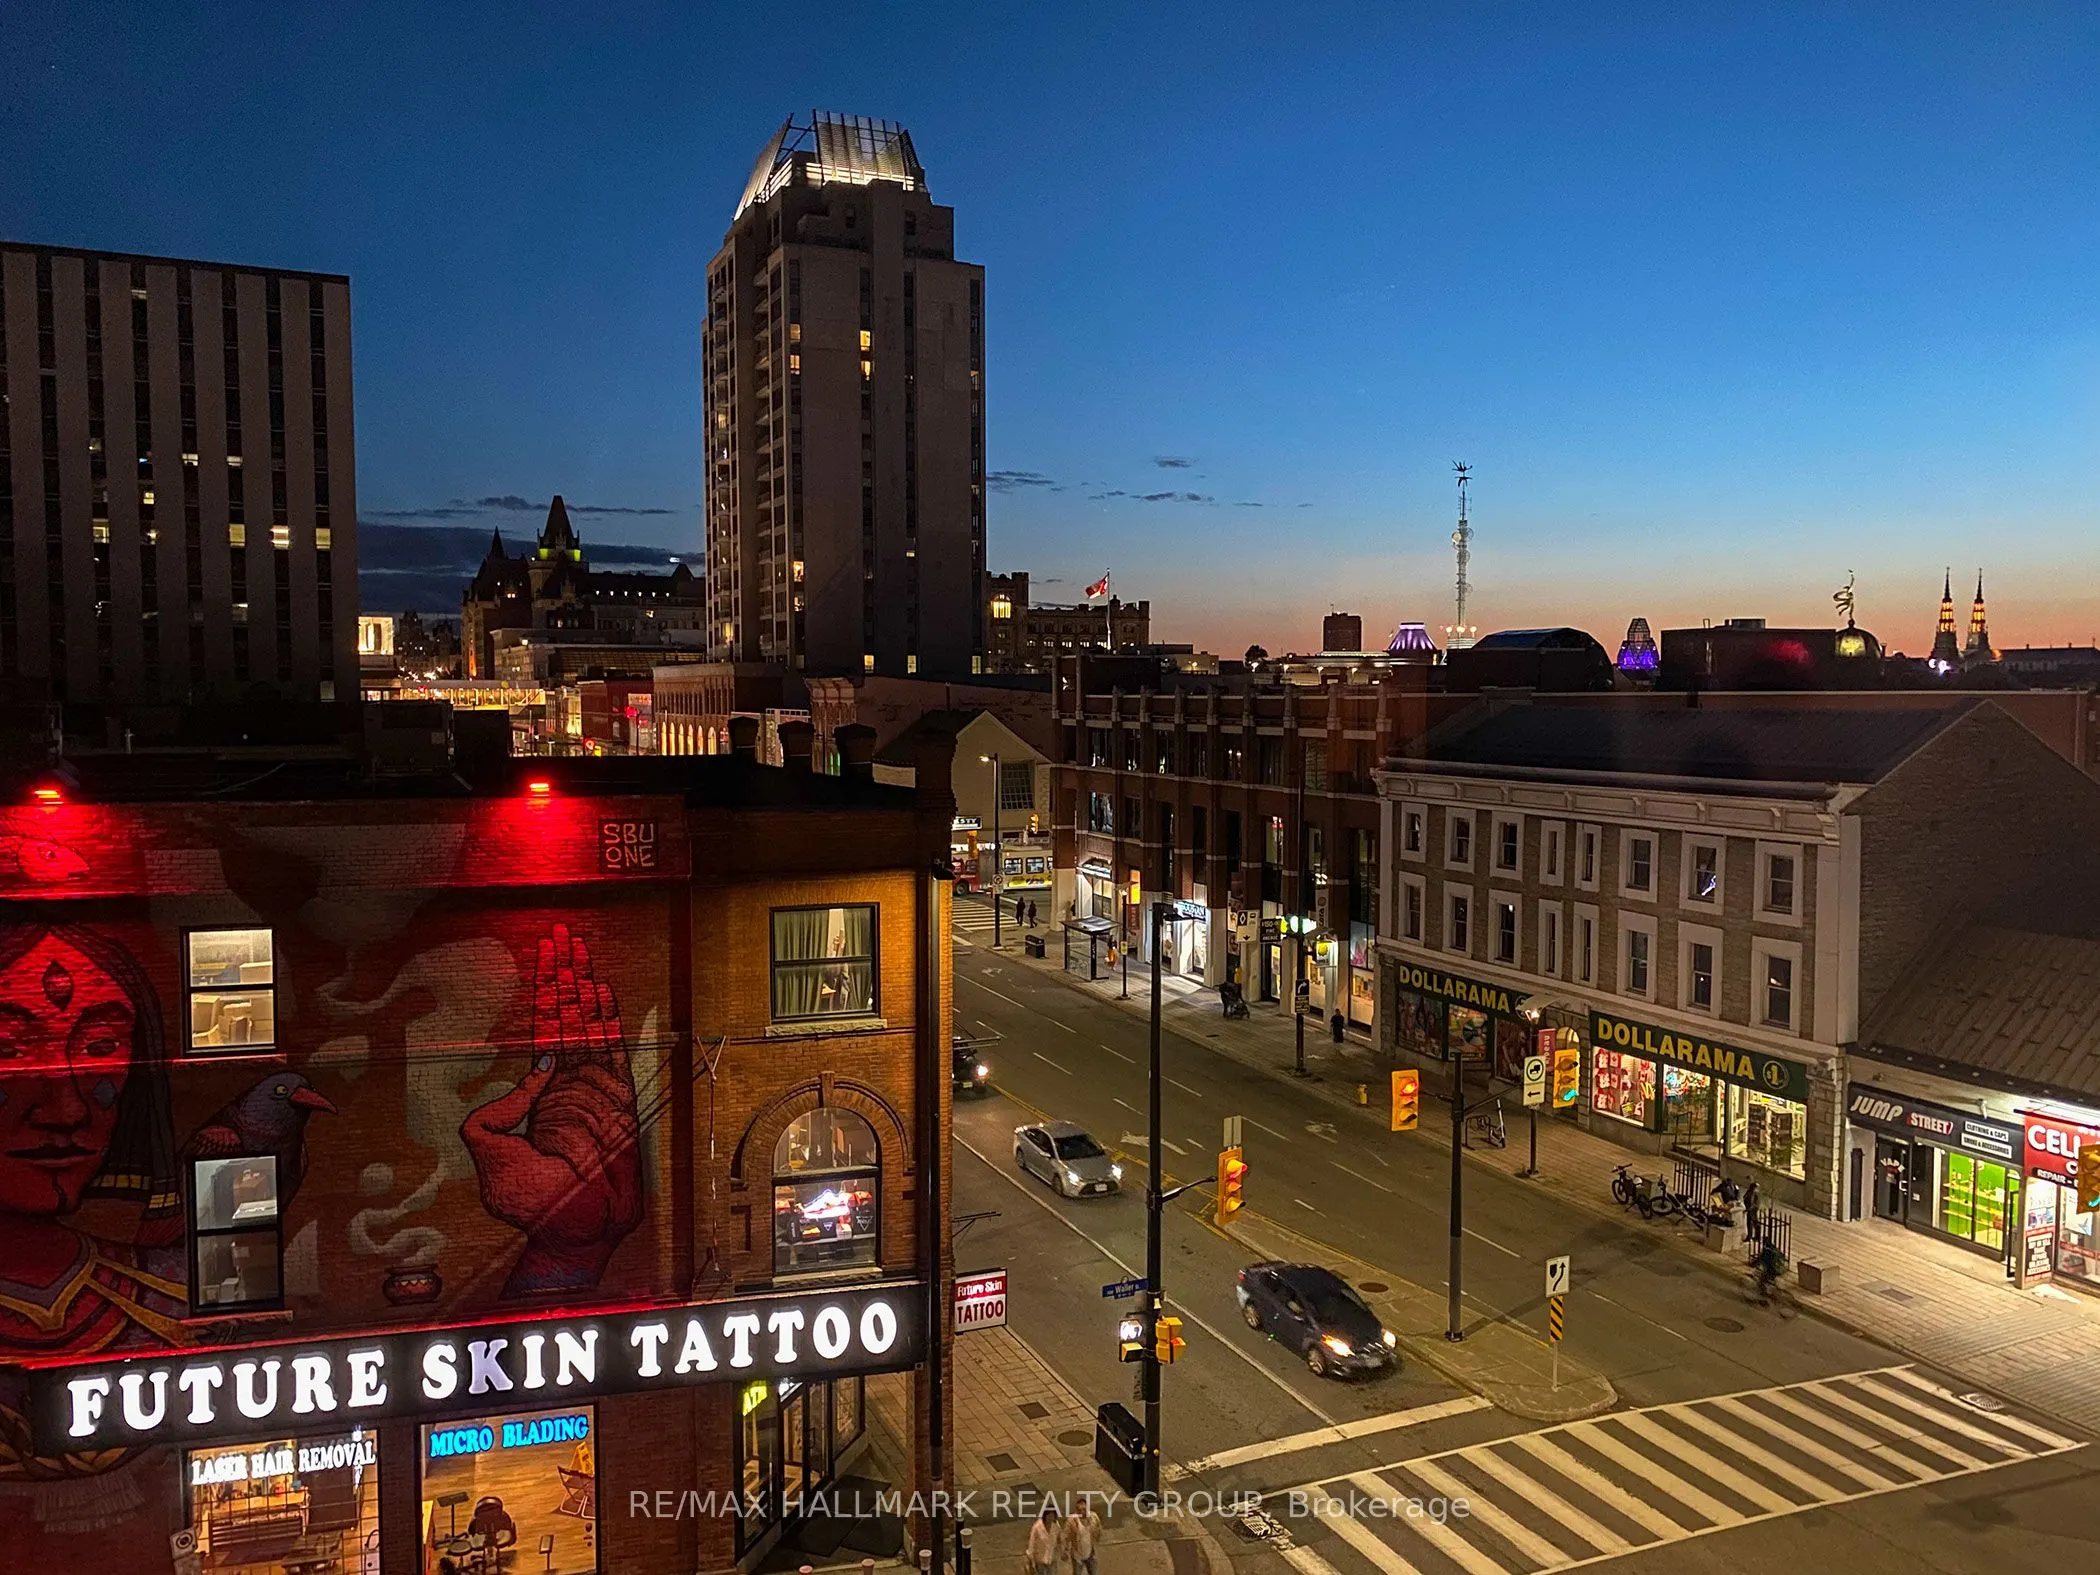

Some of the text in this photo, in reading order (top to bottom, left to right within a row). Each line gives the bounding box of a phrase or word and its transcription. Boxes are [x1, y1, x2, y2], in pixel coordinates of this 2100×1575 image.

[604, 823, 654, 844] SBU
[605, 845, 654, 868] ONE
[1399, 965, 1510, 1014] DOLLARAMA
[1597, 1018, 1755, 1081] DOLLARAMA
[1850, 1095, 1949, 1135] JUMP STREET
[1966, 1123, 1989, 1136] CLOTHING
[1994, 1130, 2007, 1140] CAPS
[2036, 1169, 2066, 1184] REPAIR
[957, 1280, 1003, 1297] Future Skin
[957, 1300, 1004, 1324] TATTOO
[68, 1301, 898, 1437] FUTURE SKIN TATTOO
[430, 1416, 590, 1458] MICRO BLADING
[191, 1441, 376, 1485] LASER HAIR REMOVAL
